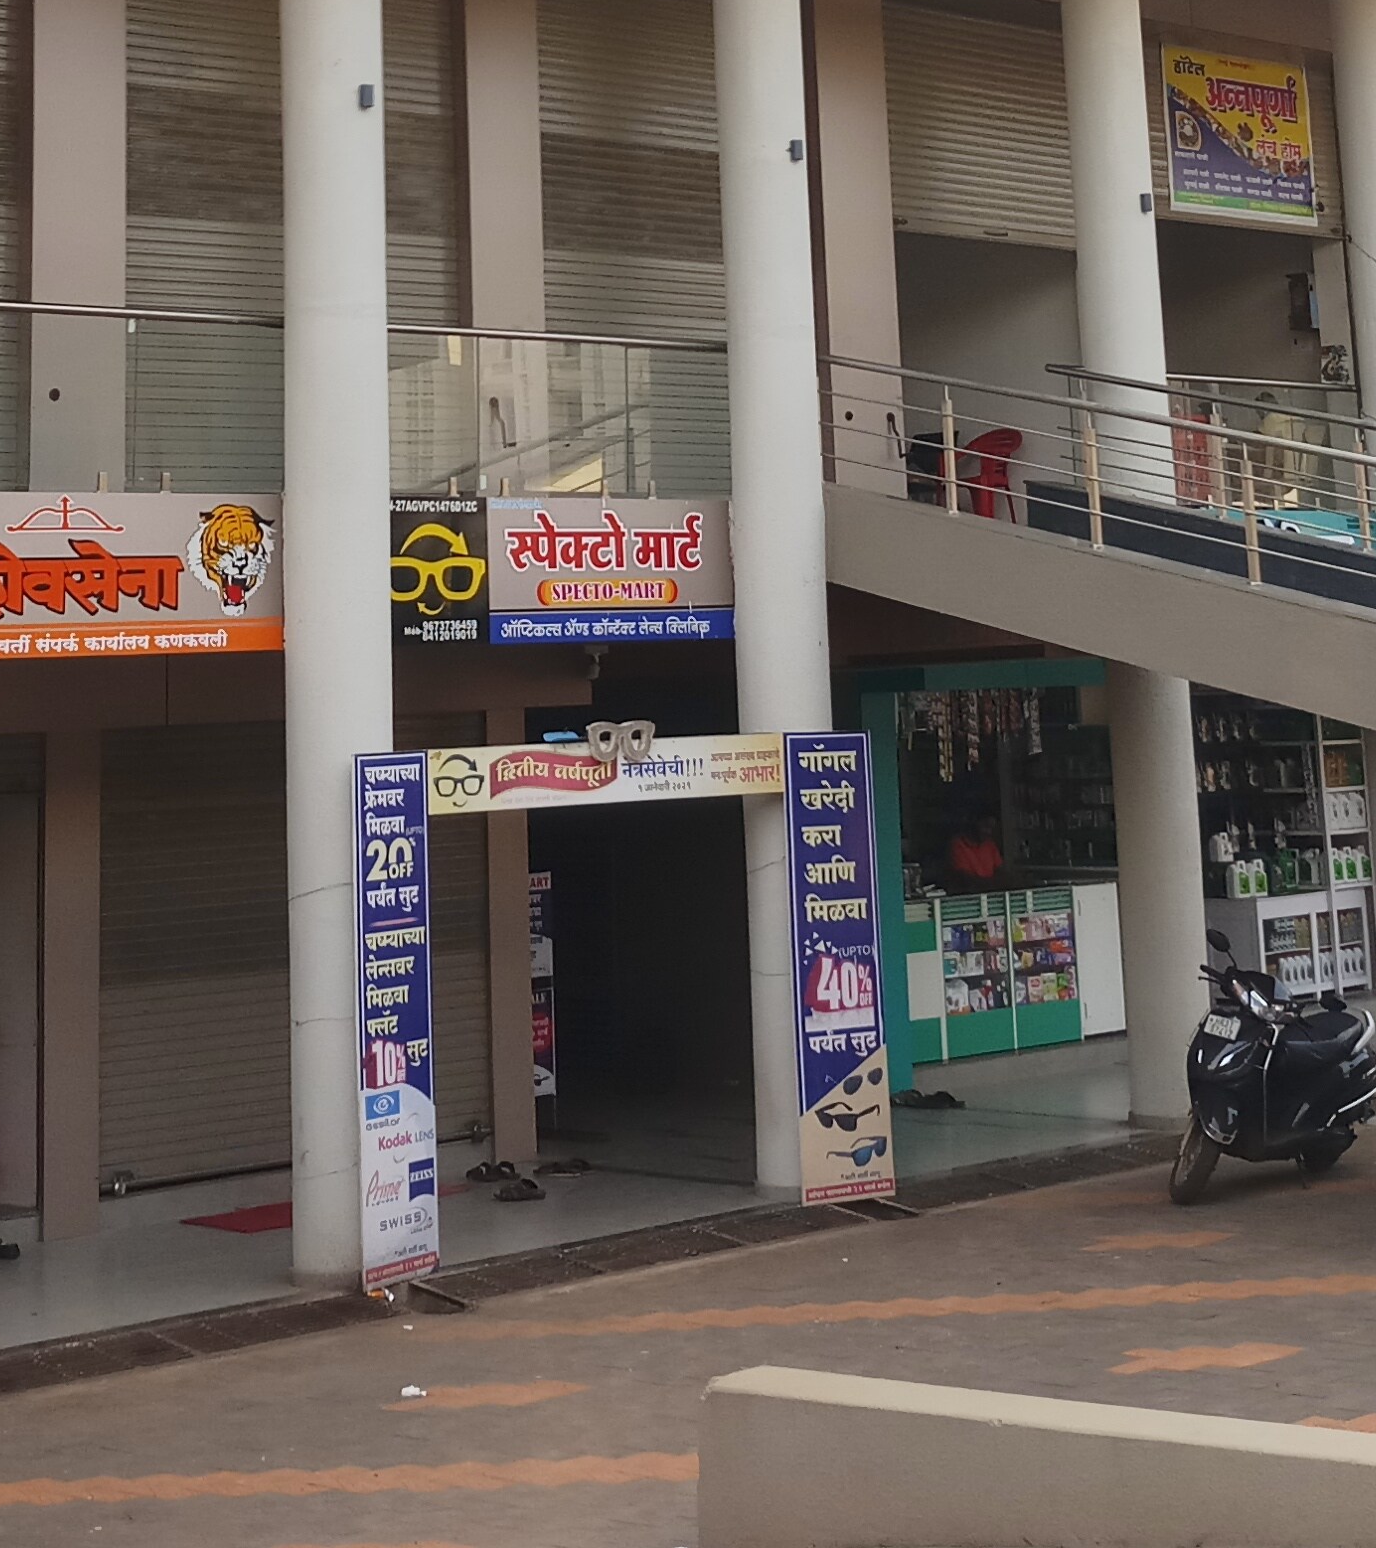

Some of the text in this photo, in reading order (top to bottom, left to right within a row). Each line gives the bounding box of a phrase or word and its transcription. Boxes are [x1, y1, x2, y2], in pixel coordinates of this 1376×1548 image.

[1173, 55, 1206, 77] हॉटेल
[504, 509, 703, 573] स्पेक्टो मार्ट
[552, 580, 666, 602] SPECTO-MART
[500, 618, 563, 638] ऑप्टिकल्स
[638, 616, 664, 635] लेन्स
[665, 615, 711, 638] क्लिनिक
[35, 631, 80, 653] संपर्क
[84, 631, 150, 652] कार्यालय
[153, 628, 228, 649] कणकवली
[798, 742, 857, 773] गॉगल
[800, 779, 856, 814] खरेदी
[365, 815, 406, 838] मिळवा
[801, 824, 842, 848] करा
[388, 860, 414, 878] OFF
[804, 854, 857, 884] आणि
[803, 892, 868, 924] मिळवा
[365, 953, 415, 982] लेन्सवर
[366, 984, 410, 1010] मिळवा
[859, 992, 873, 1006] OFF
[406, 1037, 429, 1067] सुट
[850, 1029, 878, 1058] सुट
[378, 1127, 435, 1151] Kodak LENS
[409, 1167, 435, 1183] ZEISS
